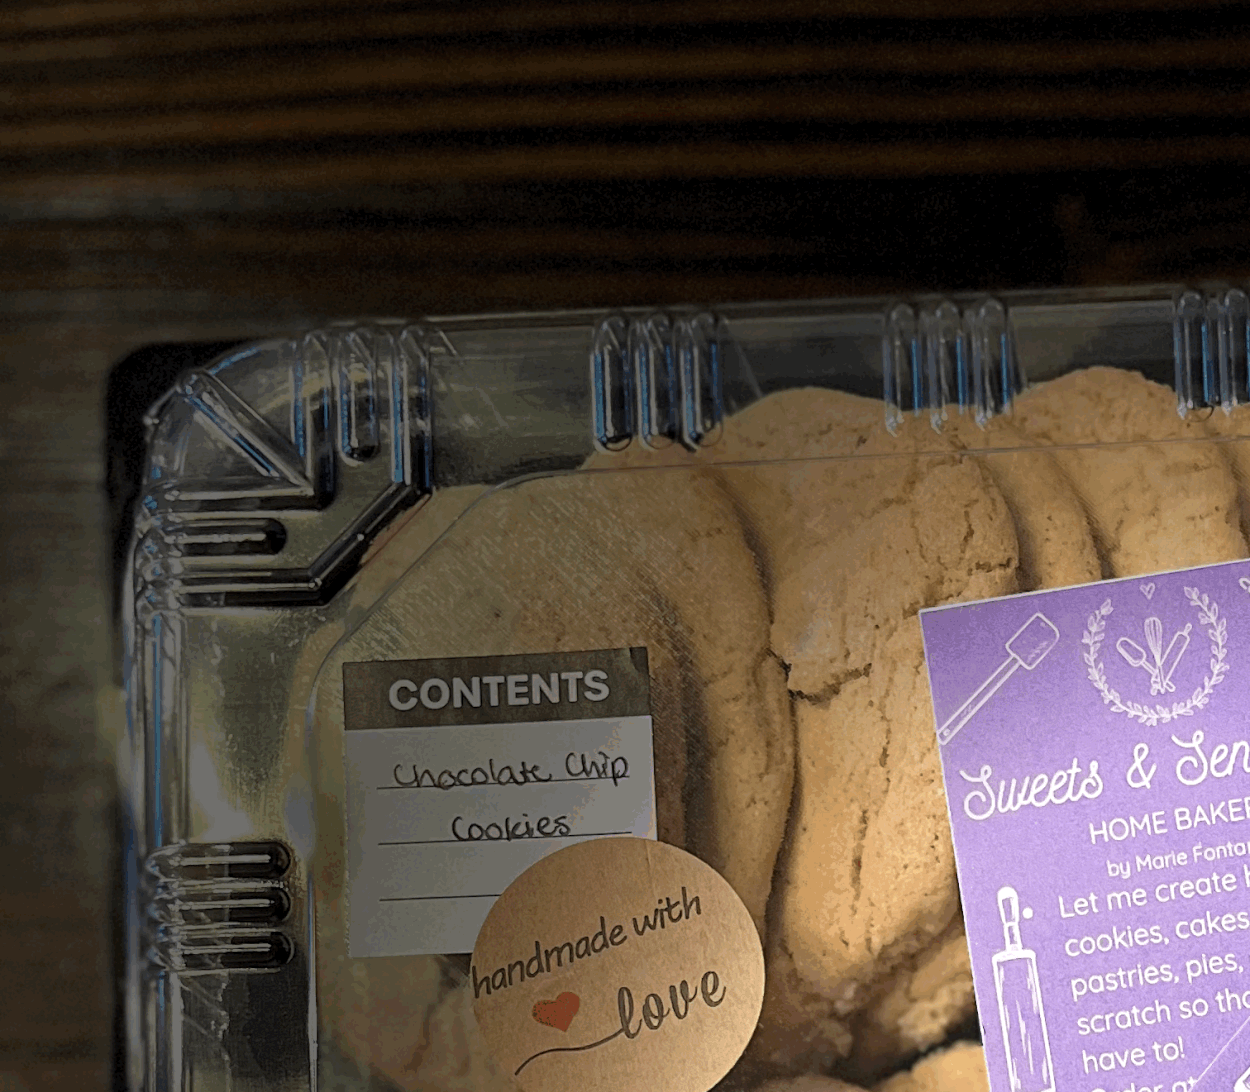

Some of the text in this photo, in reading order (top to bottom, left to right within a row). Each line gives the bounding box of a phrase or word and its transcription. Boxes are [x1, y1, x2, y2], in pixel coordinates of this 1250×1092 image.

[389, 670, 610, 711] CONTENTS
[394, 751, 628, 790] Chocolate Chip
[959, 757, 1104, 821] Sweets
[1126, 742, 1158, 790] &
[452, 813, 570, 841] Cookies
[1088, 810, 1169, 845] HOME
[1105, 859, 1132, 880] by
[1135, 850, 1188, 873] Marie
[1057, 891, 1100, 919] Let
[1106, 887, 1148, 912] me
[1155, 871, 1238, 903] create
[471, 887, 701, 998] handmade with
[1064, 924, 1170, 957] cookies,
[1070, 961, 1180, 1003] pastries,
[1185, 952, 1244, 986] pies,
[616, 970, 727, 1039] love
[1076, 999, 1172, 1036] scratch
[1178, 997, 1210, 1020] so
[1081, 1035, 1186, 1075] have to!
